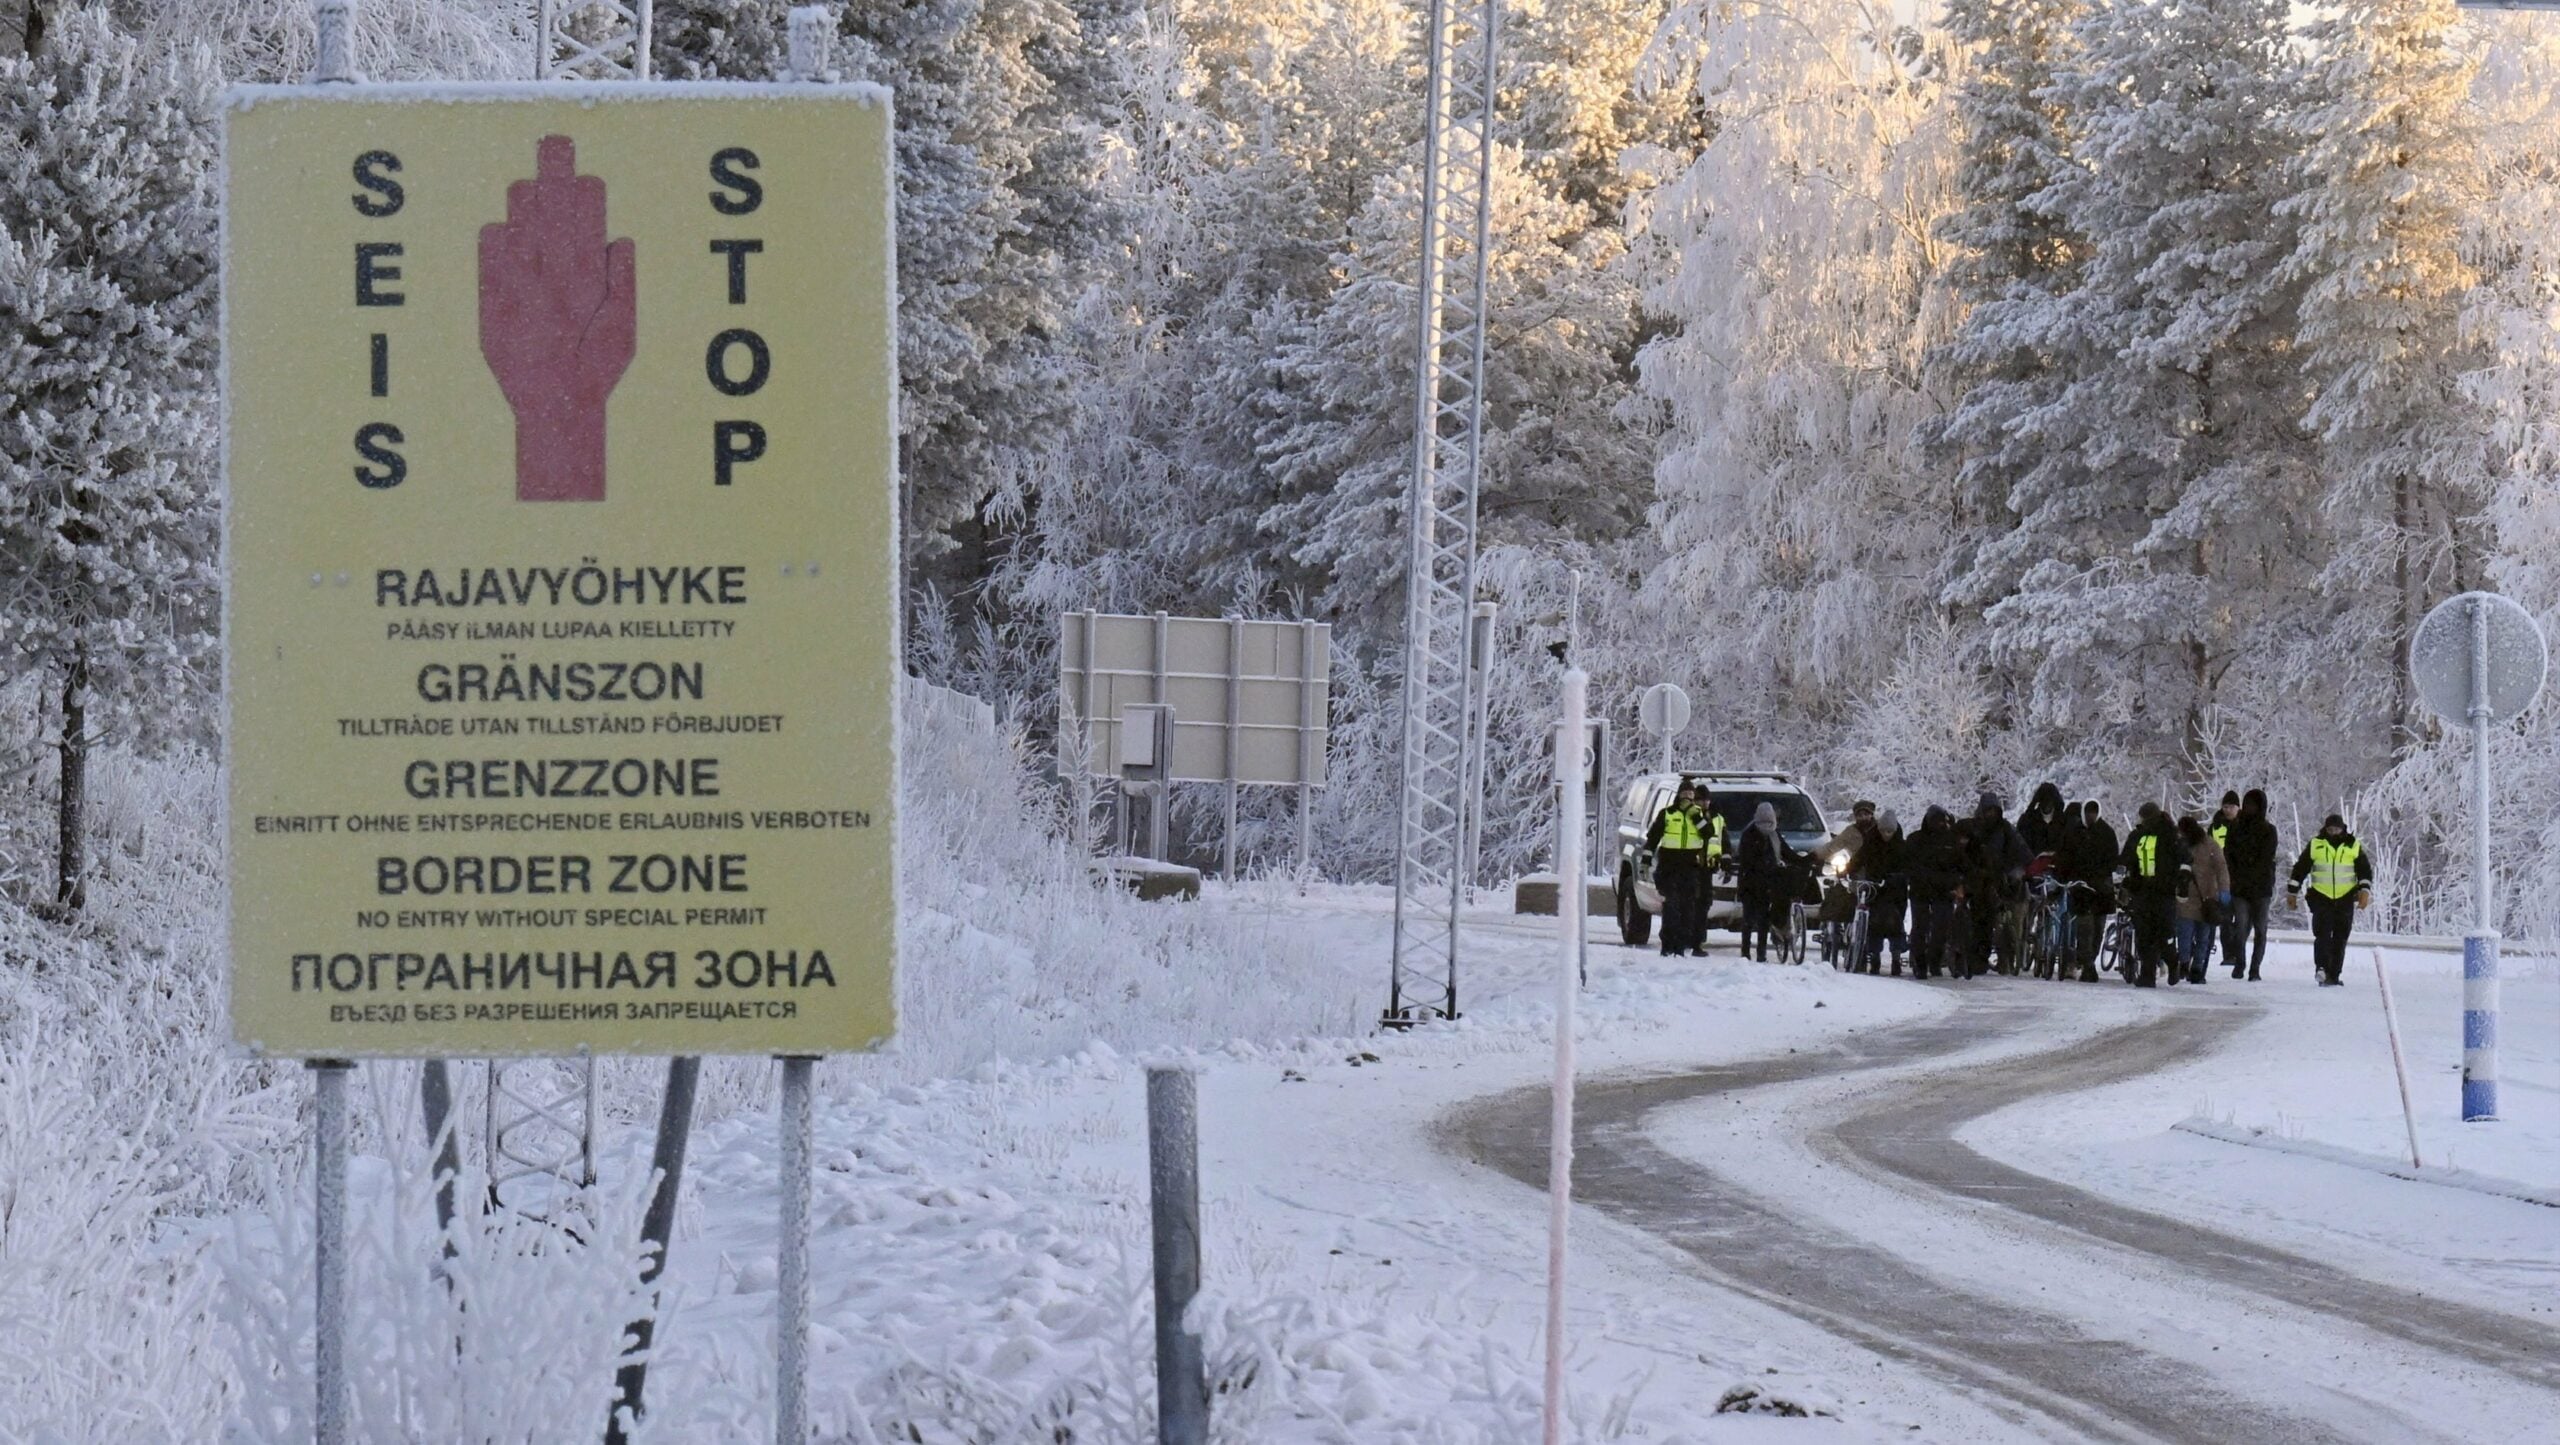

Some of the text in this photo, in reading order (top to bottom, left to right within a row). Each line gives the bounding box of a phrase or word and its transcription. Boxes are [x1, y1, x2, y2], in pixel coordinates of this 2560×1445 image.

[352, 150, 407, 489] SEIS
[706, 147, 770, 485] STOP
[376, 557, 747, 607] RAJAVYÖHYKE
[467, 621, 534, 640] ILMAN
[543, 620, 612, 639] LUPAA
[620, 619, 735, 639] KIELLETTY
[417, 653, 704, 702] GRÄNSZON
[461, 718, 519, 736] UTAN
[653, 712, 783, 734] FÖRBJUDET
[405, 758, 720, 799] GRENZZONE
[254, 810, 870, 833] EINRITT OHNE ENTSPRECHENDE ERLAUBNIS VERBOTEN
[378, 854, 748, 896] BORDER ZONE
[358, 907, 766, 928] NO ENTRY WITHOUT SPECIAL PERMIT
[291, 949, 837, 992] ПОГРАНИЧНАЯ ЗОНА
[330, 1001, 797, 1023] ВЪЕЗД БЕЗ РАЗРЕШЕНИЯ ЗАПРЕЩАЕТСЯ
